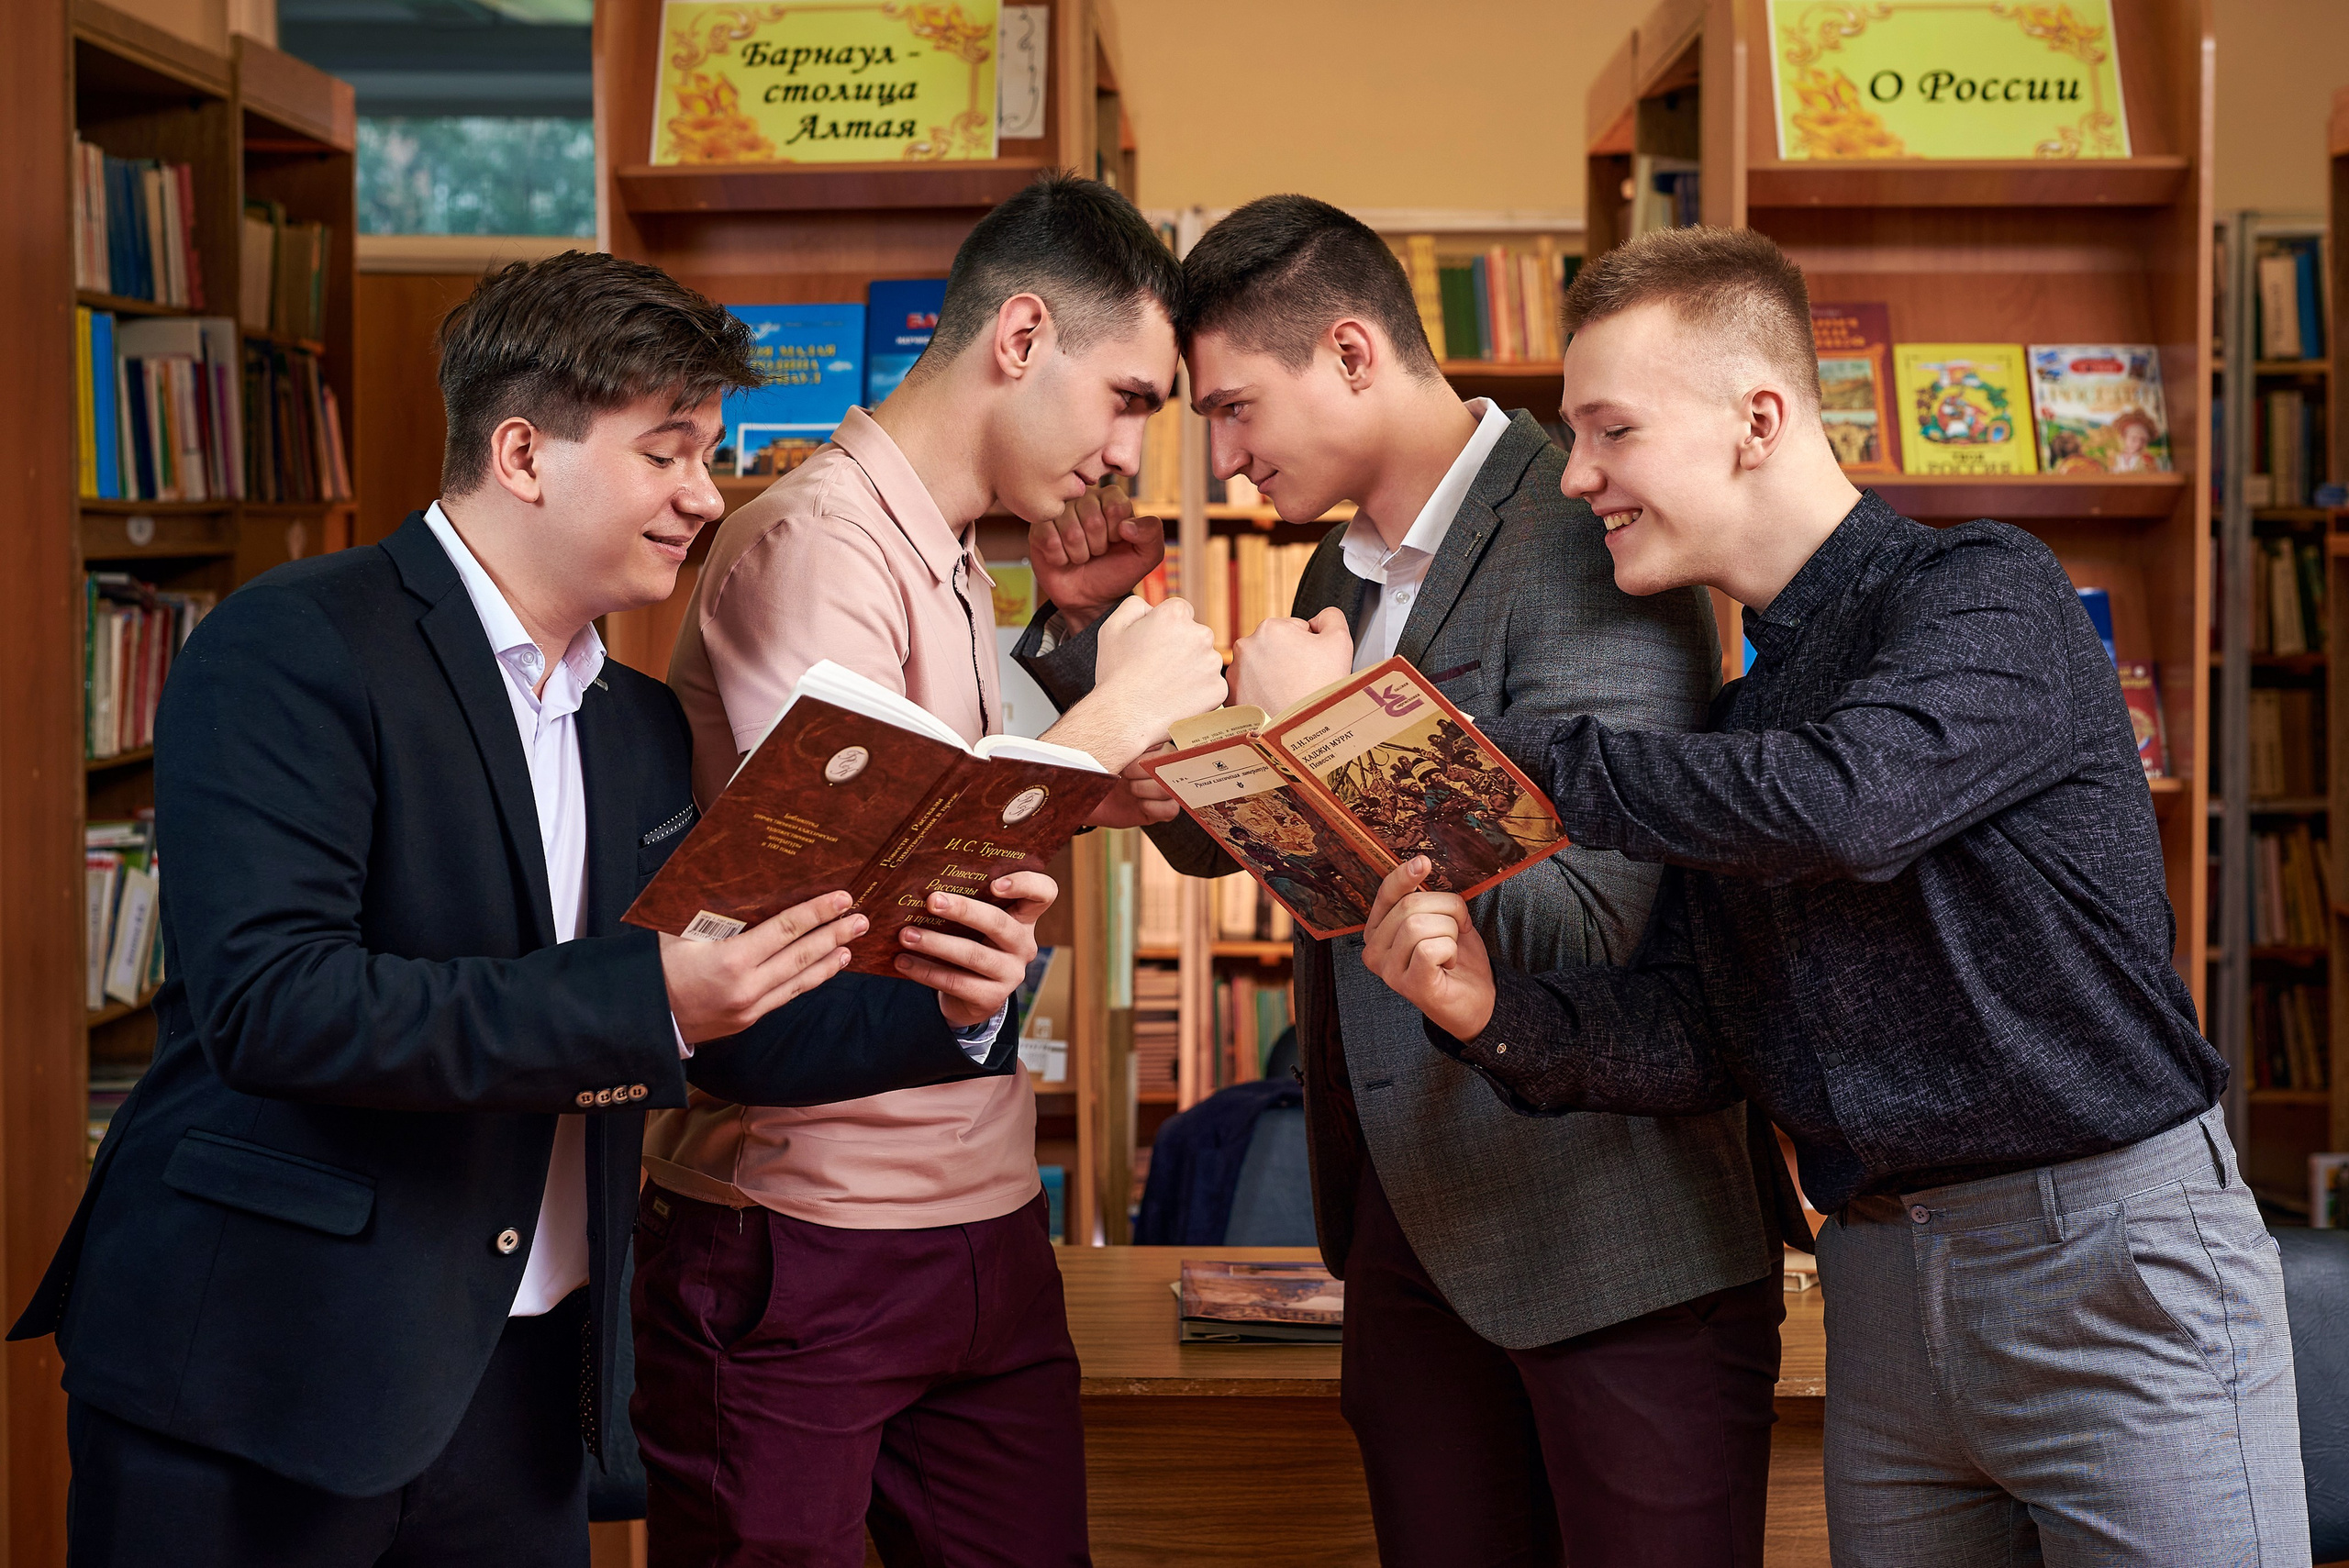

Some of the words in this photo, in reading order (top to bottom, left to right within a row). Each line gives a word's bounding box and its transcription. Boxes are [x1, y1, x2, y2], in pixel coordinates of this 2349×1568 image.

[741, 40, 896, 73] Барнаул
[763, 80, 918, 108] столица
[1869, 70, 1904, 103] О
[1919, 69, 2082, 104] России
[785, 114, 918, 145] Алтая
[1309, 753, 1335, 770] Повести
[879, 838, 909, 867] Повести
[911, 797, 944, 831] Рассказы
[979, 841, 1026, 860] Тургенев
[941, 864, 988, 882] Повести
[925, 878, 979, 895] Рассказы
[905, 914, 914, 922] в
[913, 915, 946, 926] прозе
